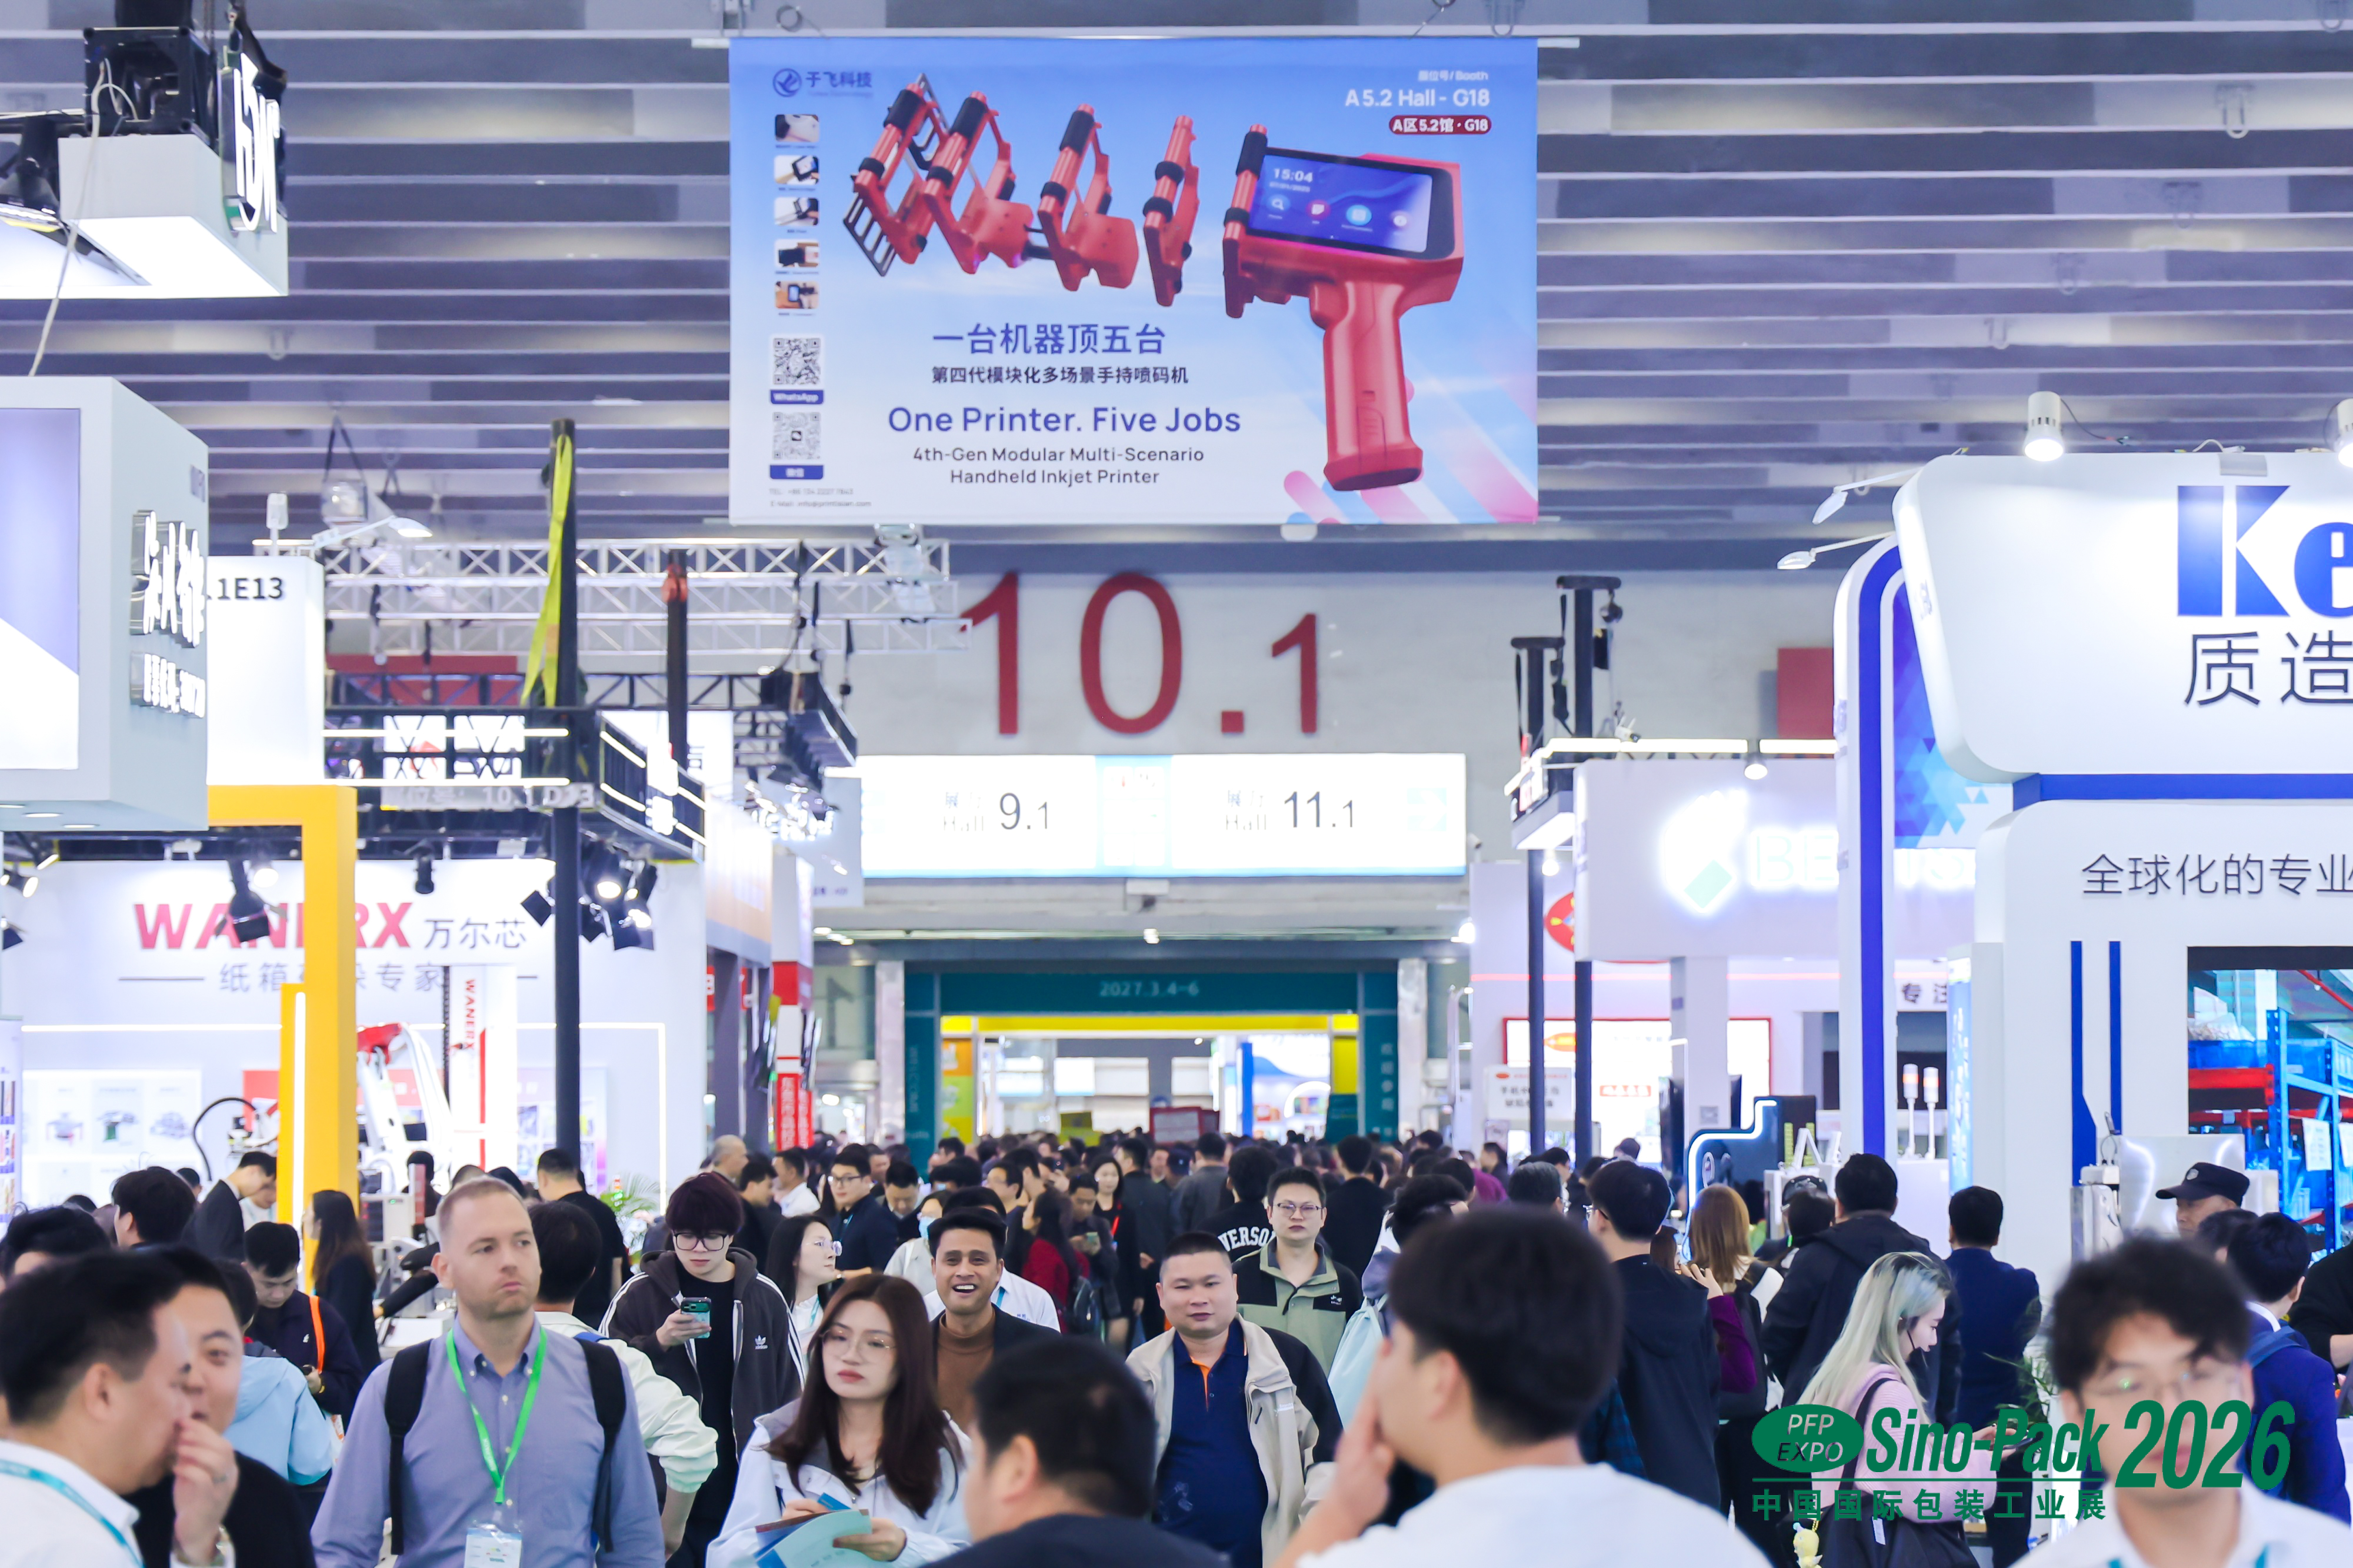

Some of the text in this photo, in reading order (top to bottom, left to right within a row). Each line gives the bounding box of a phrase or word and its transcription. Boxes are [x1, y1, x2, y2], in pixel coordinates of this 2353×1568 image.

[1398, 89, 1435, 106] Hall
[1453, 89, 1490, 106] G18
[1274, 168, 1313, 183] 15:04
[933, 323, 1165, 354] 一台机器顶五台
[932, 366, 1188, 383] 第四代模块化多场景手持喷码机
[888, 407, 1241, 432] One Printer. Five Jobs
[913, 448, 1205, 462] 4th-Gen Modular Multi-Scenario
[951, 470, 1159, 487] Handheld Inkjet Printer
[959, 572, 1317, 735] 10.1
[2184, 630, 2353, 706] 质造
[999, 792, 1048, 830] 9.1
[1284, 791, 1352, 828] 11.1
[424, 918, 526, 949] 万尔芯
